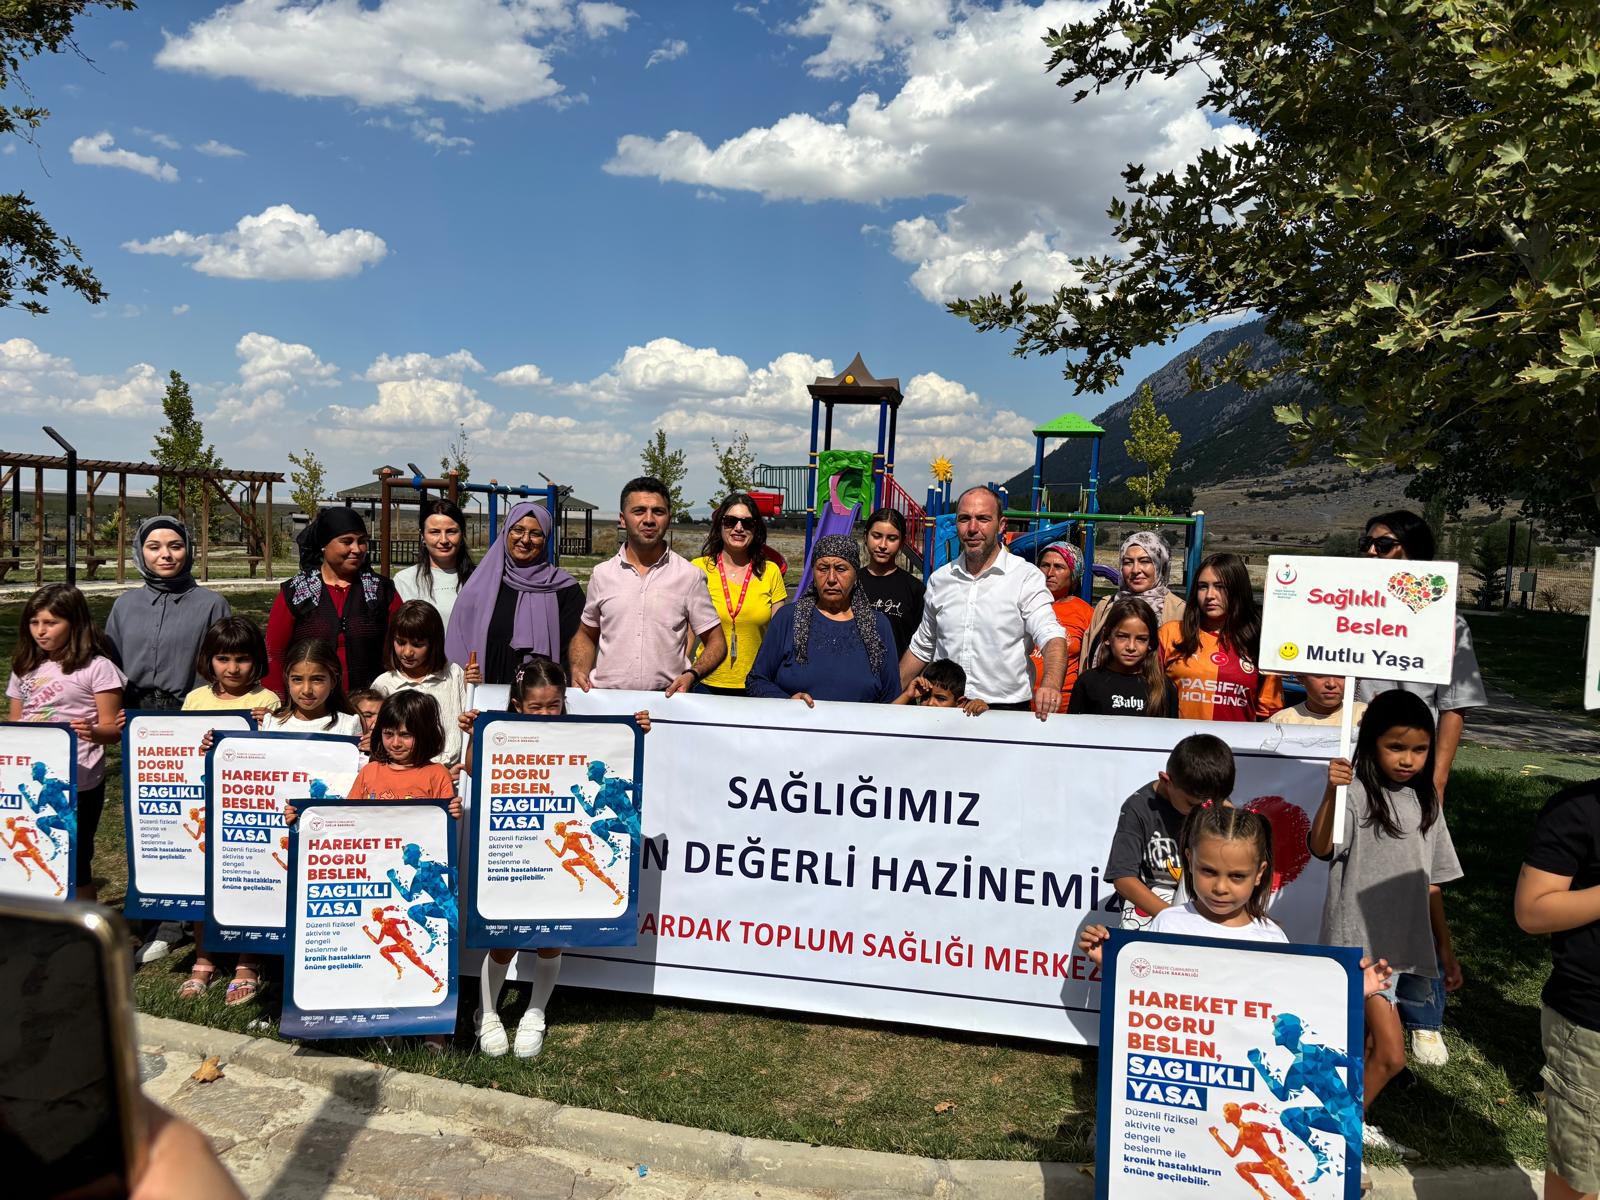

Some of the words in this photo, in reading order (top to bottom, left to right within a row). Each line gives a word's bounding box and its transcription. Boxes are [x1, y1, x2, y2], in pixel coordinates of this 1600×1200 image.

[1307, 588, 1387, 610] Sağlıklı
[1336, 616, 1408, 638] Beslen
[1306, 645, 1364, 664] Mutlu
[1371, 650, 1424, 671] Yaşa
[1111, 694, 1144, 711] Baby
[138, 746, 195, 756] HAREKET
[491, 753, 565, 766] HAREKET
[138, 773, 187, 784] BESLEN,
[222, 769, 289, 782] HAREKET
[491, 782, 554, 796] BESLEN,
[222, 797, 279, 812] BESLEN,
[727, 770, 980, 827] SAĞLIĞIMIZ
[308, 838, 381, 850] HAREKET
[684, 836, 855, 888] DEĞERLİ
[307, 868, 371, 881] BESLEN,
[638, 913, 732, 942] ARDAK
[739, 920, 854, 955] TOPLUM
[861, 930, 975, 968] SAĞLIĞI
[1129, 989, 1238, 1016] HAREKET
[1244, 1000, 1277, 1023] ET,
[1127, 1032, 1222, 1062] BESLEN,
[1125, 1107, 1161, 1119] Düzenli
[1164, 1113, 1198, 1126] fiziksel
[1124, 1120, 1160, 1132] aktivite
[1124, 1132, 1161, 1143] dengeli
[1124, 1143, 1172, 1157] beslenme
[1174, 1151, 1187, 1159] ile
[1123, 1154, 1156, 1166] kronik
[1158, 1159, 1222, 1176] hastalıkların
[1123, 1166, 1155, 1177] önüne
[1157, 1172, 1210, 1187] geçilebilir.
